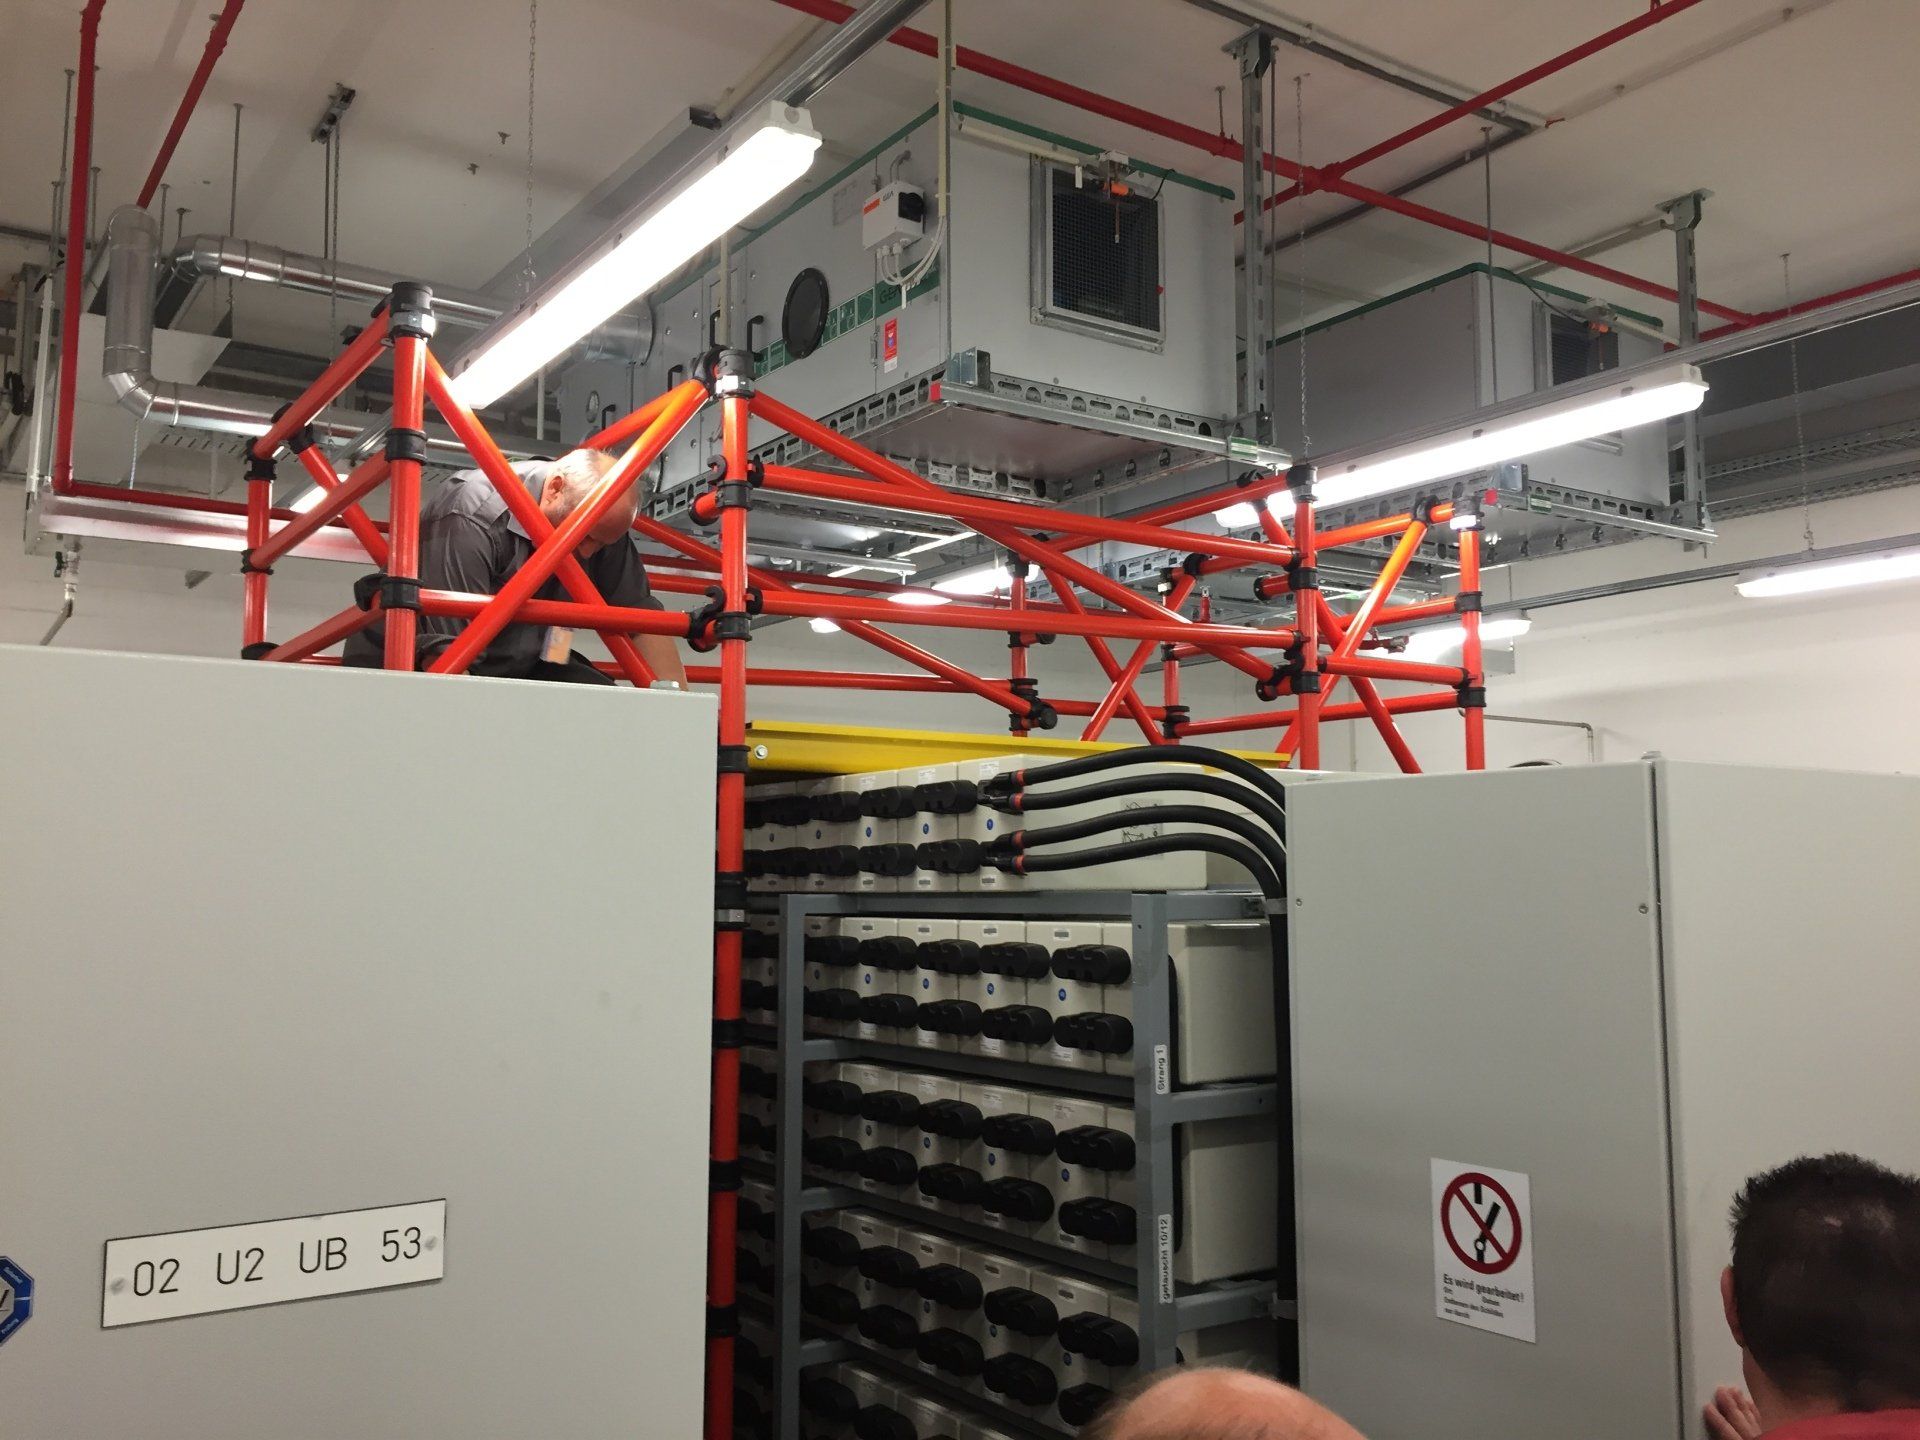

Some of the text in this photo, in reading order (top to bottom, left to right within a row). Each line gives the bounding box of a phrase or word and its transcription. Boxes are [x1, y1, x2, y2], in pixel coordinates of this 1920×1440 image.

[1157, 1057, 1166, 1091] Strang
[1160, 1219, 1168, 1247] 10/12
[134, 1226, 421, 1296] 02 U2 UB 53
[1443, 1273, 1453, 1285] Es
[1455, 1278, 1474, 1290] wird
[1476, 1285, 1524, 1302] gearbeitet!
